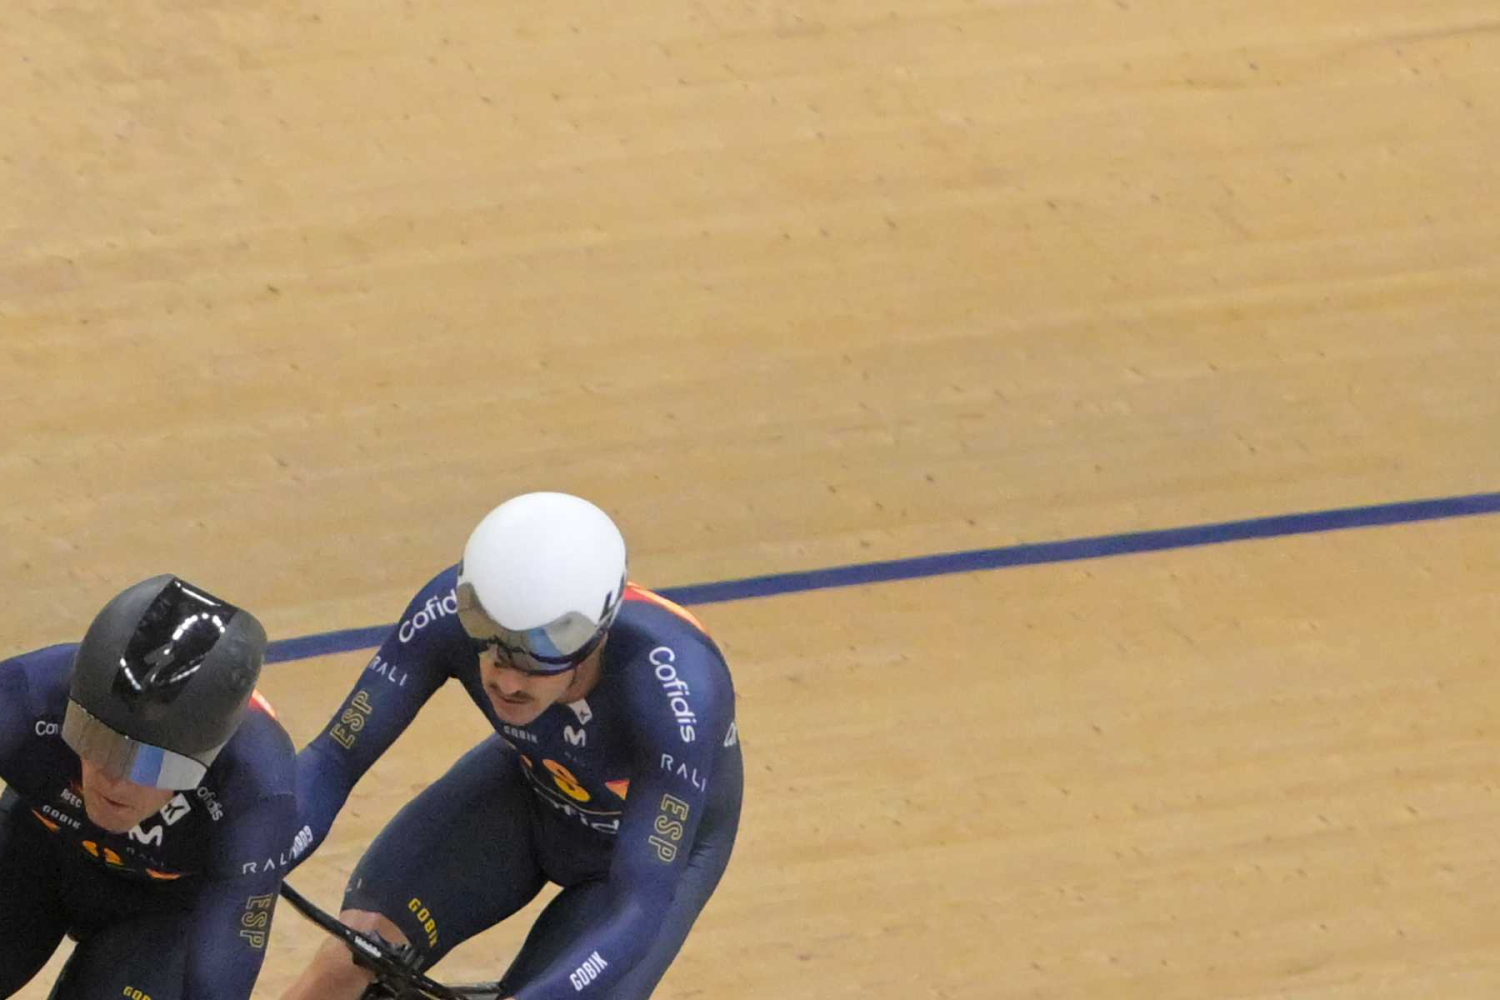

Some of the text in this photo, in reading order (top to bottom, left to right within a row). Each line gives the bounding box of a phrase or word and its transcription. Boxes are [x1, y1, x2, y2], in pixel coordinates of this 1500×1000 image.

[368, 655, 408, 687] RALI
[649, 646, 697, 743] Cofidis
[329, 689, 373, 750] ESP
[660, 753, 707, 792] RALI
[648, 793, 690, 863] ESP
[240, 892, 273, 949] ESP
[569, 950, 608, 992] GOBIK
